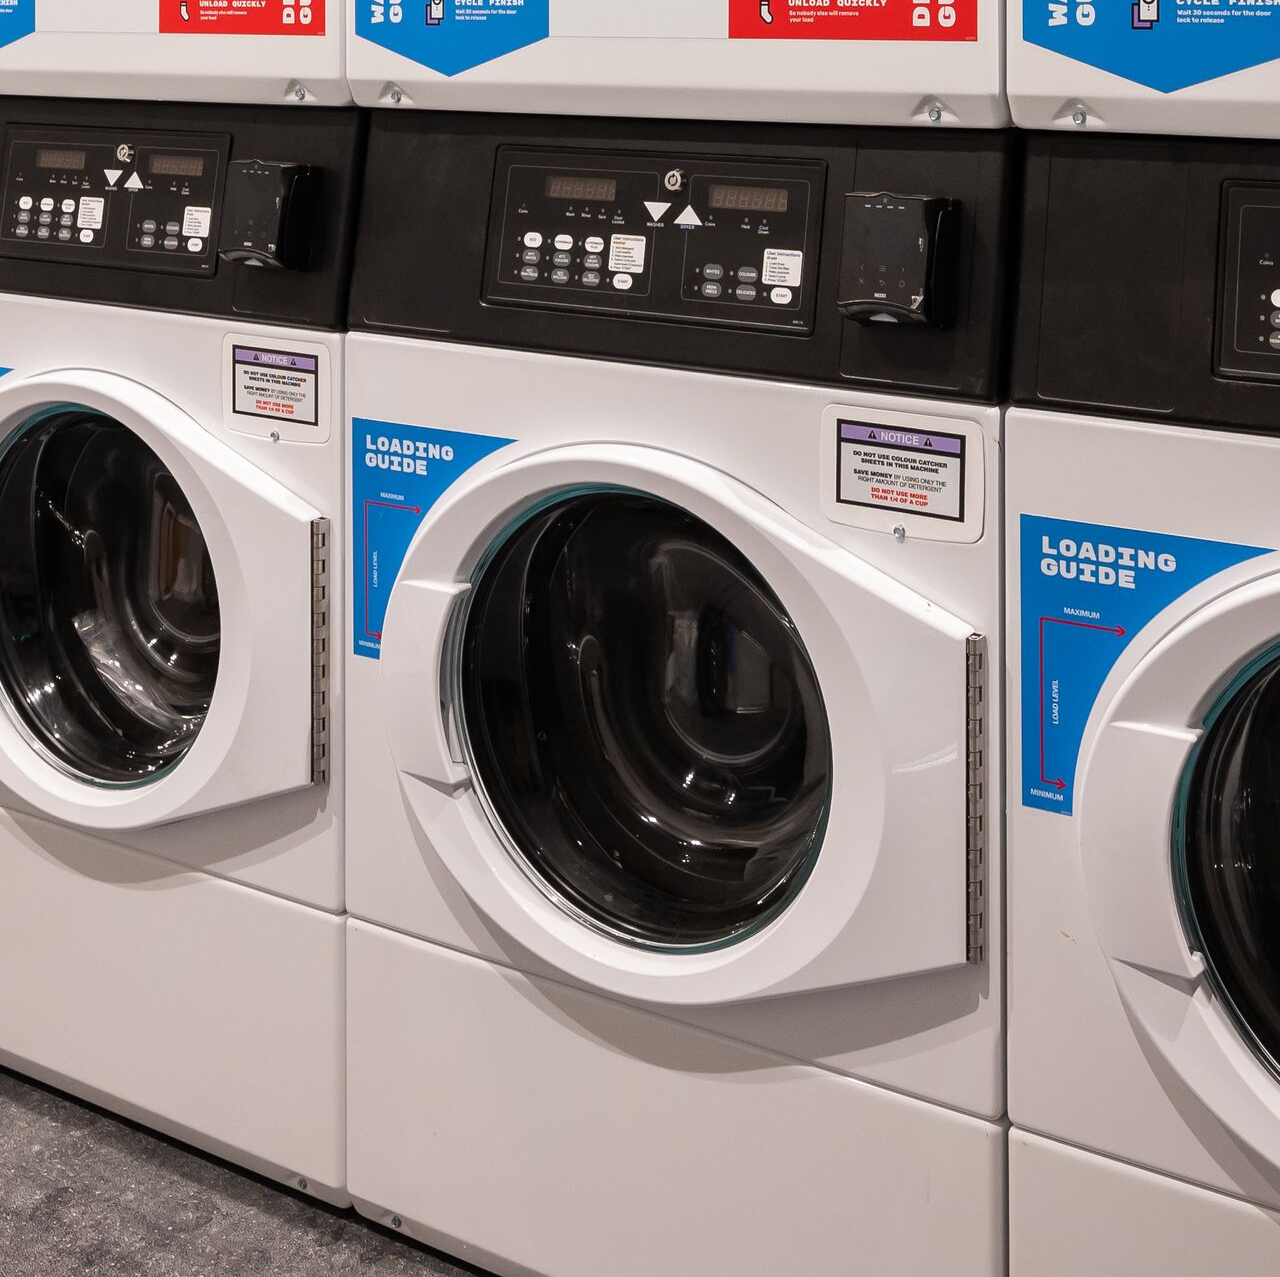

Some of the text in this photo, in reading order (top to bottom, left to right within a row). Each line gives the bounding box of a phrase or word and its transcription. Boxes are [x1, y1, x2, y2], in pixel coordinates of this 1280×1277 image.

[261, 354, 287, 364] NOTICE
[880, 431, 919, 445] NOTICE
[366, 434, 453, 461] LOADING
[365, 453, 427, 475] GUIDE
[1042, 535, 1176, 572] LOADING
[1040, 558, 1135, 589] GUIDE
[1063, 606, 1099, 619] MAXIMUM
[1030, 788, 1063, 801] MINIMUM
